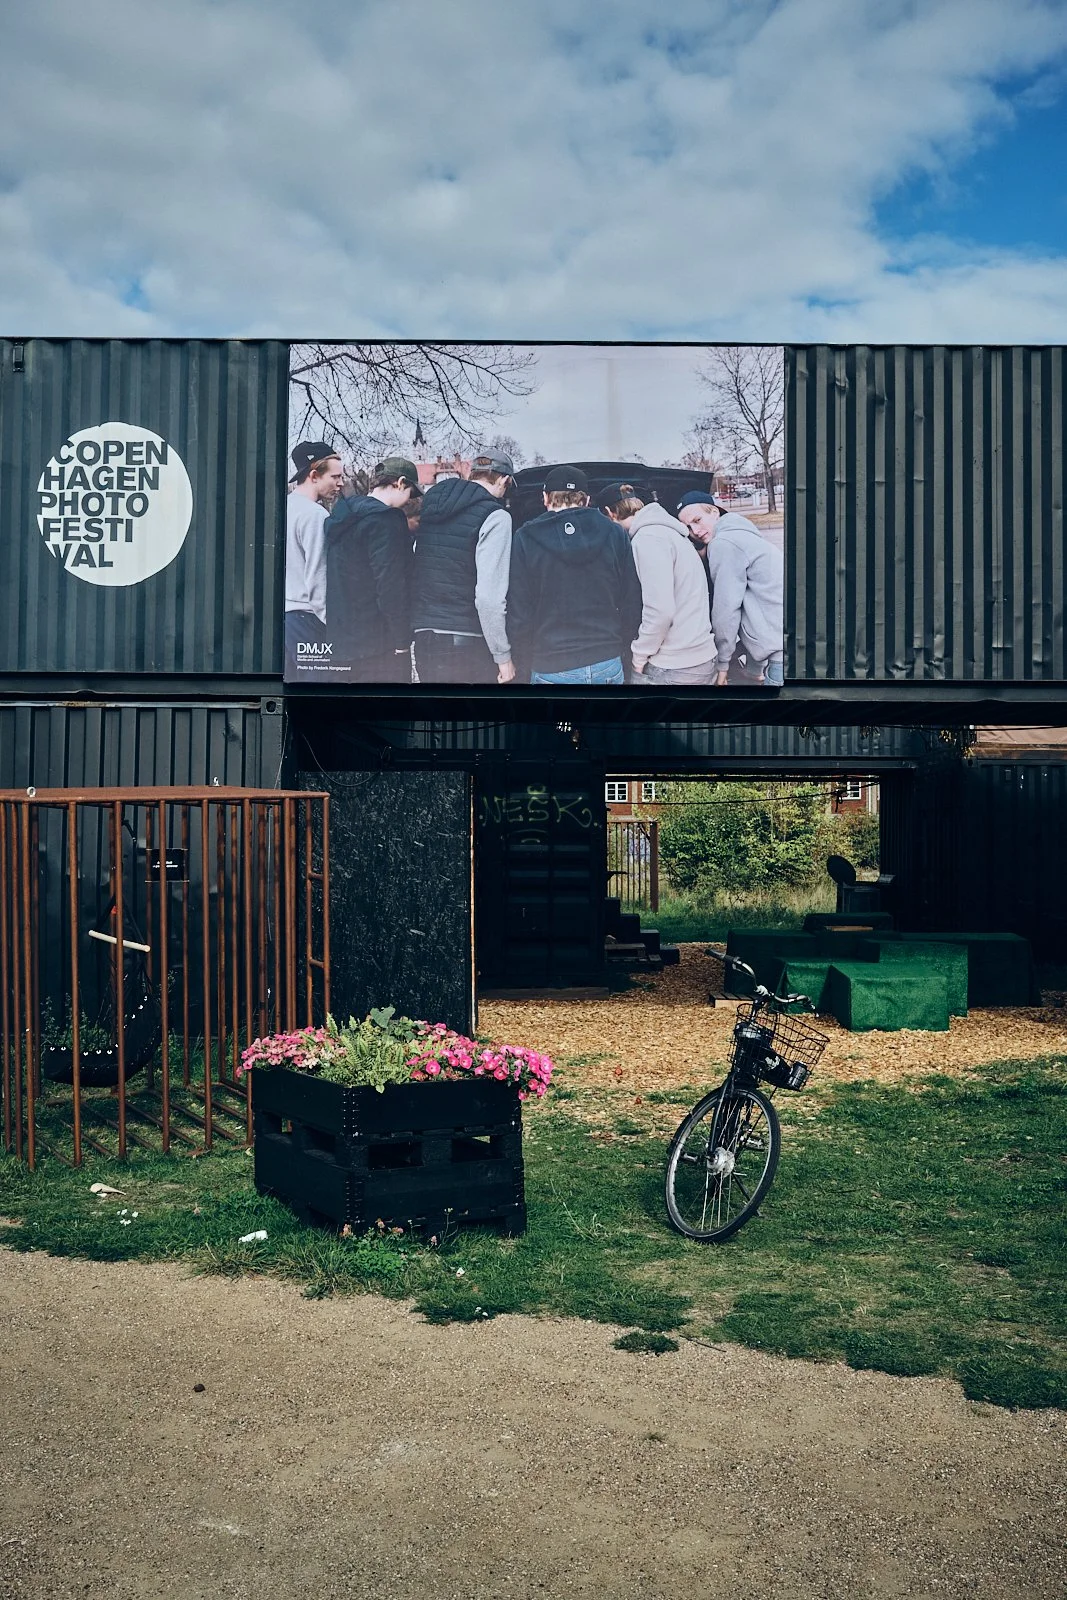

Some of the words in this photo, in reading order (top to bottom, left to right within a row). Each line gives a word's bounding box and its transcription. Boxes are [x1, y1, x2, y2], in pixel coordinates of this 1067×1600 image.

[53, 440, 169, 466] COPEN
[43, 466, 160, 491] HAGEN
[37, 492, 149, 517] PHOTO
[43, 517, 133, 542] FESTI
[53, 543, 114, 568] VAL
[297, 643, 333, 654] DMJX
